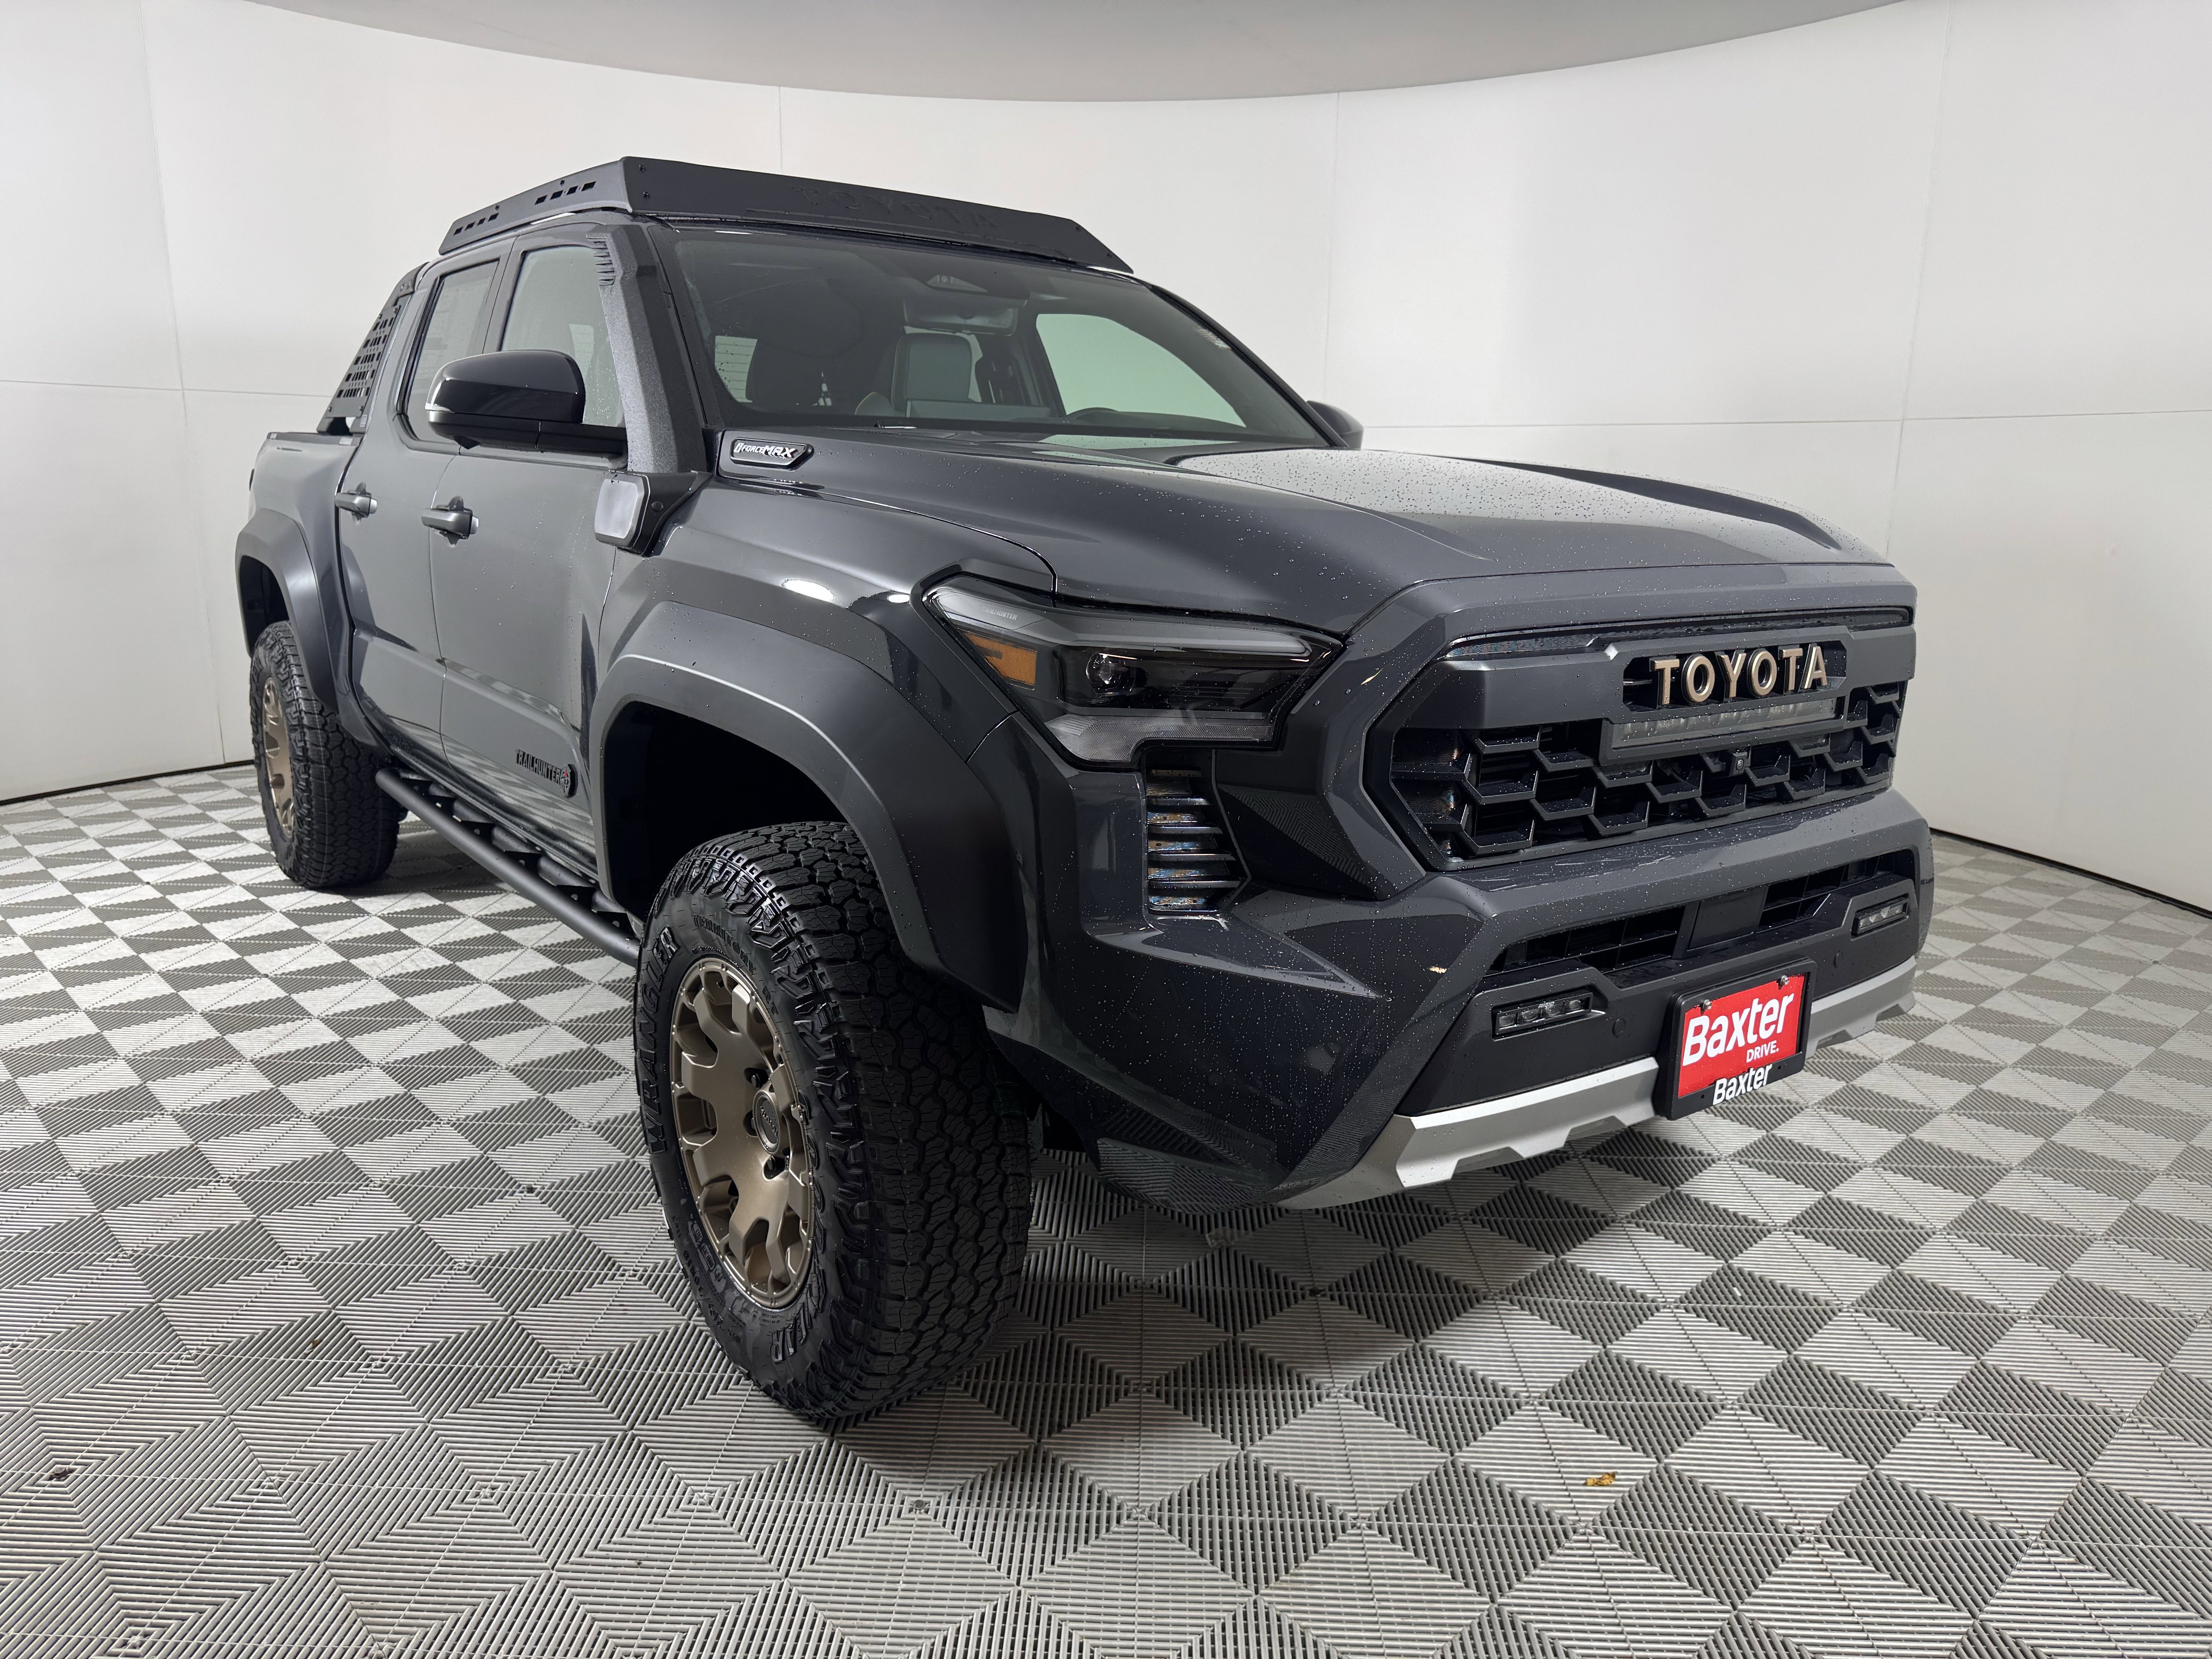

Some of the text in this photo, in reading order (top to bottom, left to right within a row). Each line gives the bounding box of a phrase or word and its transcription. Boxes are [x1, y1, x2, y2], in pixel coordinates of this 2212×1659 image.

[1650, 645, 1828, 706] TOYOTA
[515, 749, 562, 785] TRAILHUNTER
[637, 925, 681, 1154] WRANGLER
[1682, 993, 1795, 1066] Baxter
[1746, 1039, 1779, 1063] DRIVE.
[1712, 1063, 1772, 1106] Baxter
